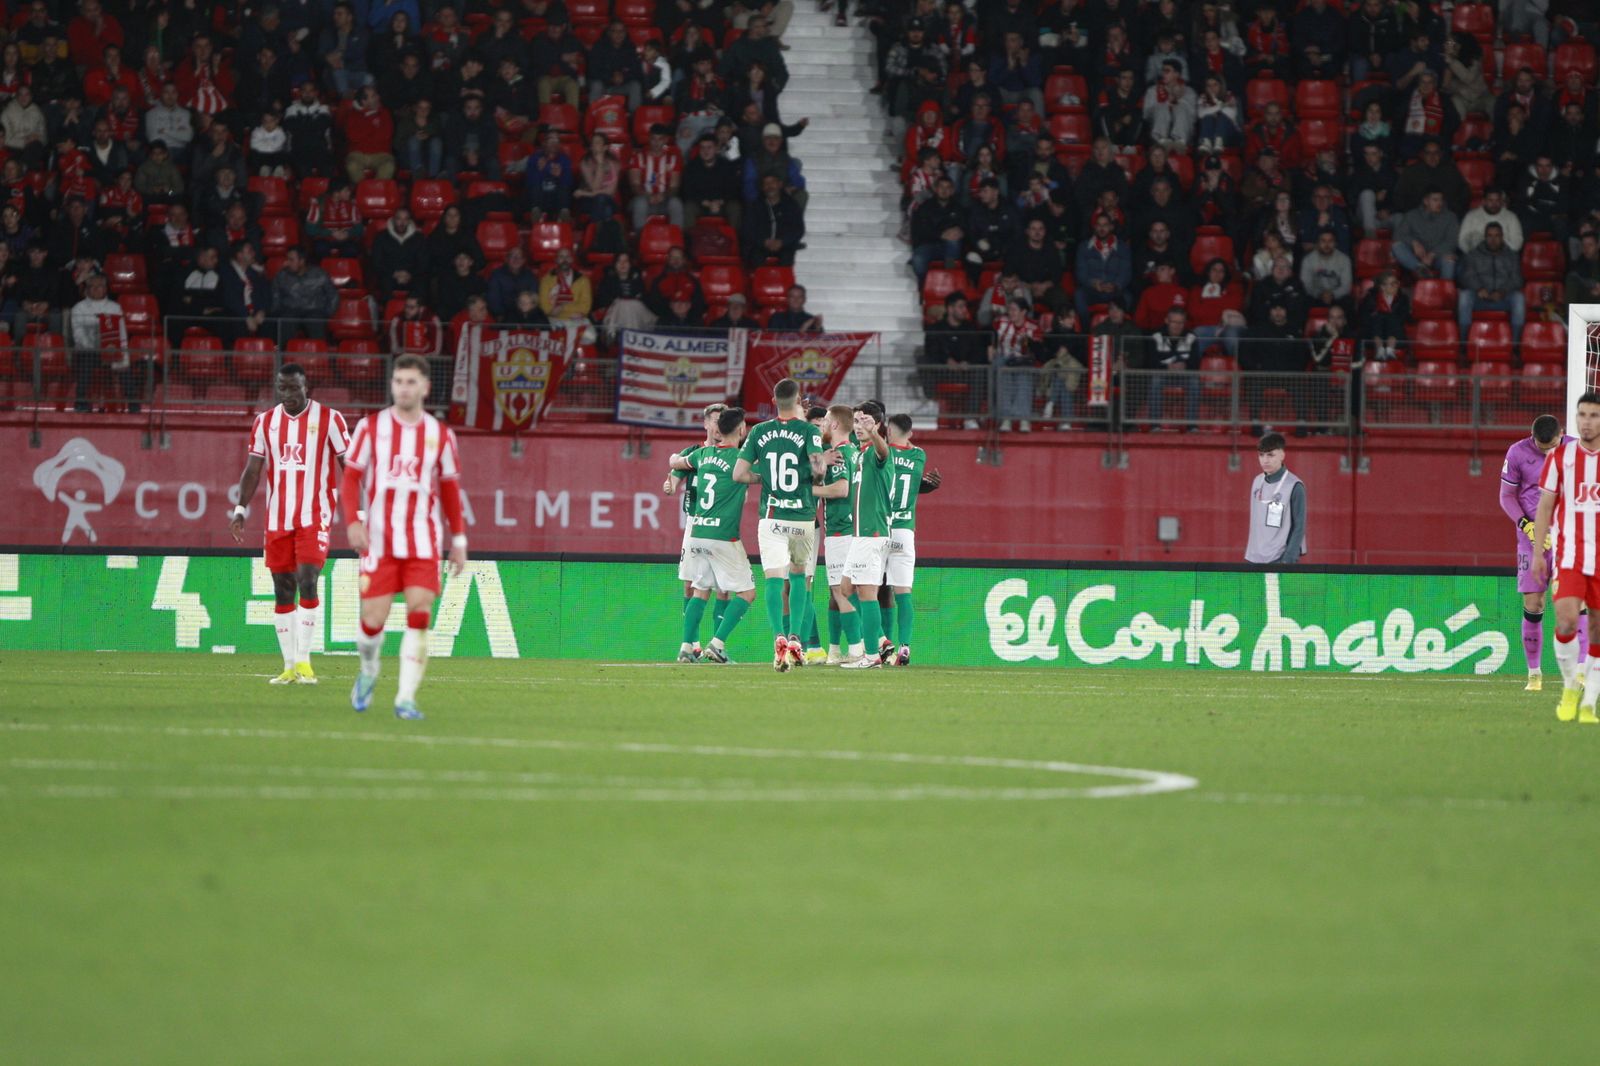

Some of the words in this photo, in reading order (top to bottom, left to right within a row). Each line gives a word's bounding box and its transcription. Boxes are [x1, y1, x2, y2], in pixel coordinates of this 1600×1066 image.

[663, 338, 728, 353] ALMER
[757, 430, 778, 448] RAFA
[894, 456, 914, 470] IOJA
[765, 452, 799, 492] 16
[699, 473, 718, 510] 3
[767, 495, 803, 508] DIGI
[692, 516, 720, 526] DIGI
[984, 578, 1059, 662] El
[1064, 584, 1241, 668] Corte
